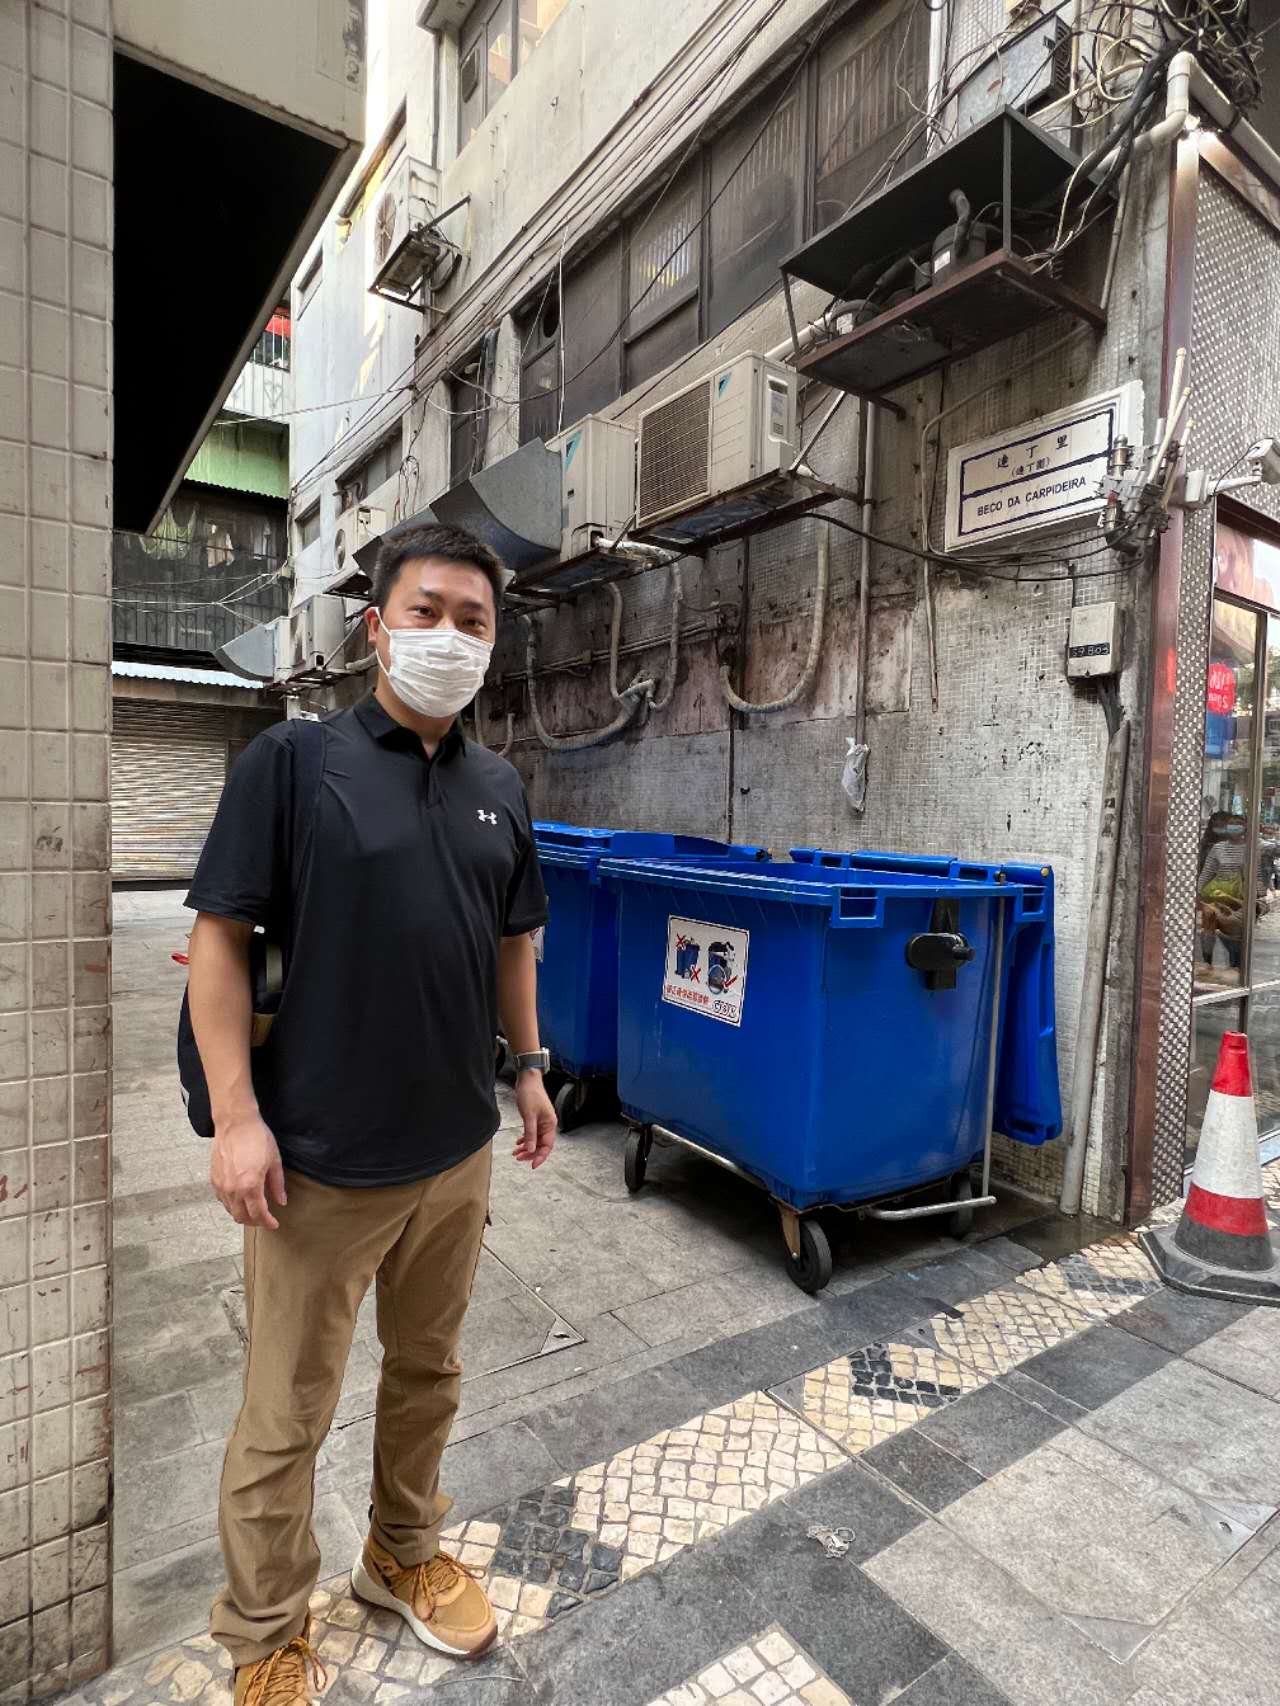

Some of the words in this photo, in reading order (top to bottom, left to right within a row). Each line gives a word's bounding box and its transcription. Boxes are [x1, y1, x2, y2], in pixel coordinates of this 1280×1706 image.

[977, 500, 1003, 517] BECO
[1007, 494, 1021, 509] DA
[1025, 476, 1087, 503] CARPIDEIRA
